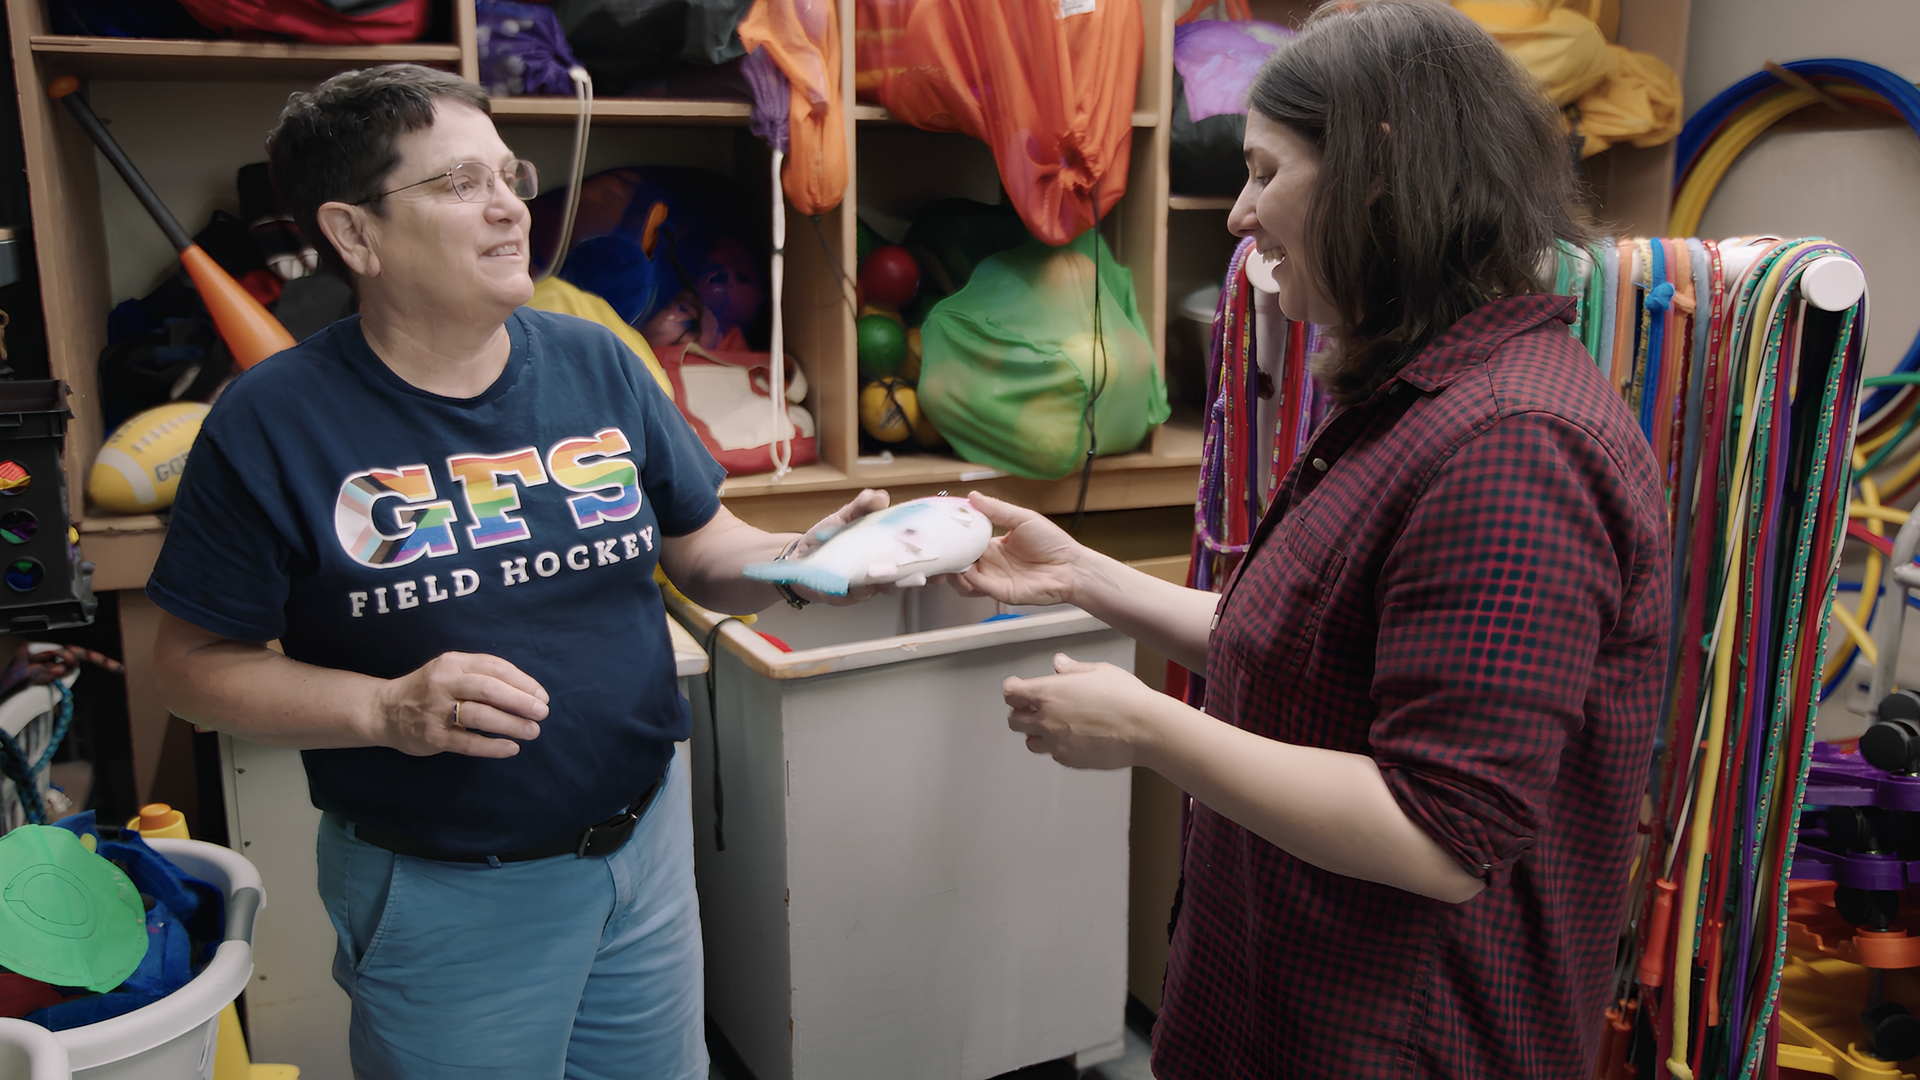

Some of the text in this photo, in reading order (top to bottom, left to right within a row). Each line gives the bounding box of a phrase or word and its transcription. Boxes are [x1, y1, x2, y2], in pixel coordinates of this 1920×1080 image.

[335, 427, 642, 569] GFS
[350, 526, 654, 617] FIELD HOCKEY
